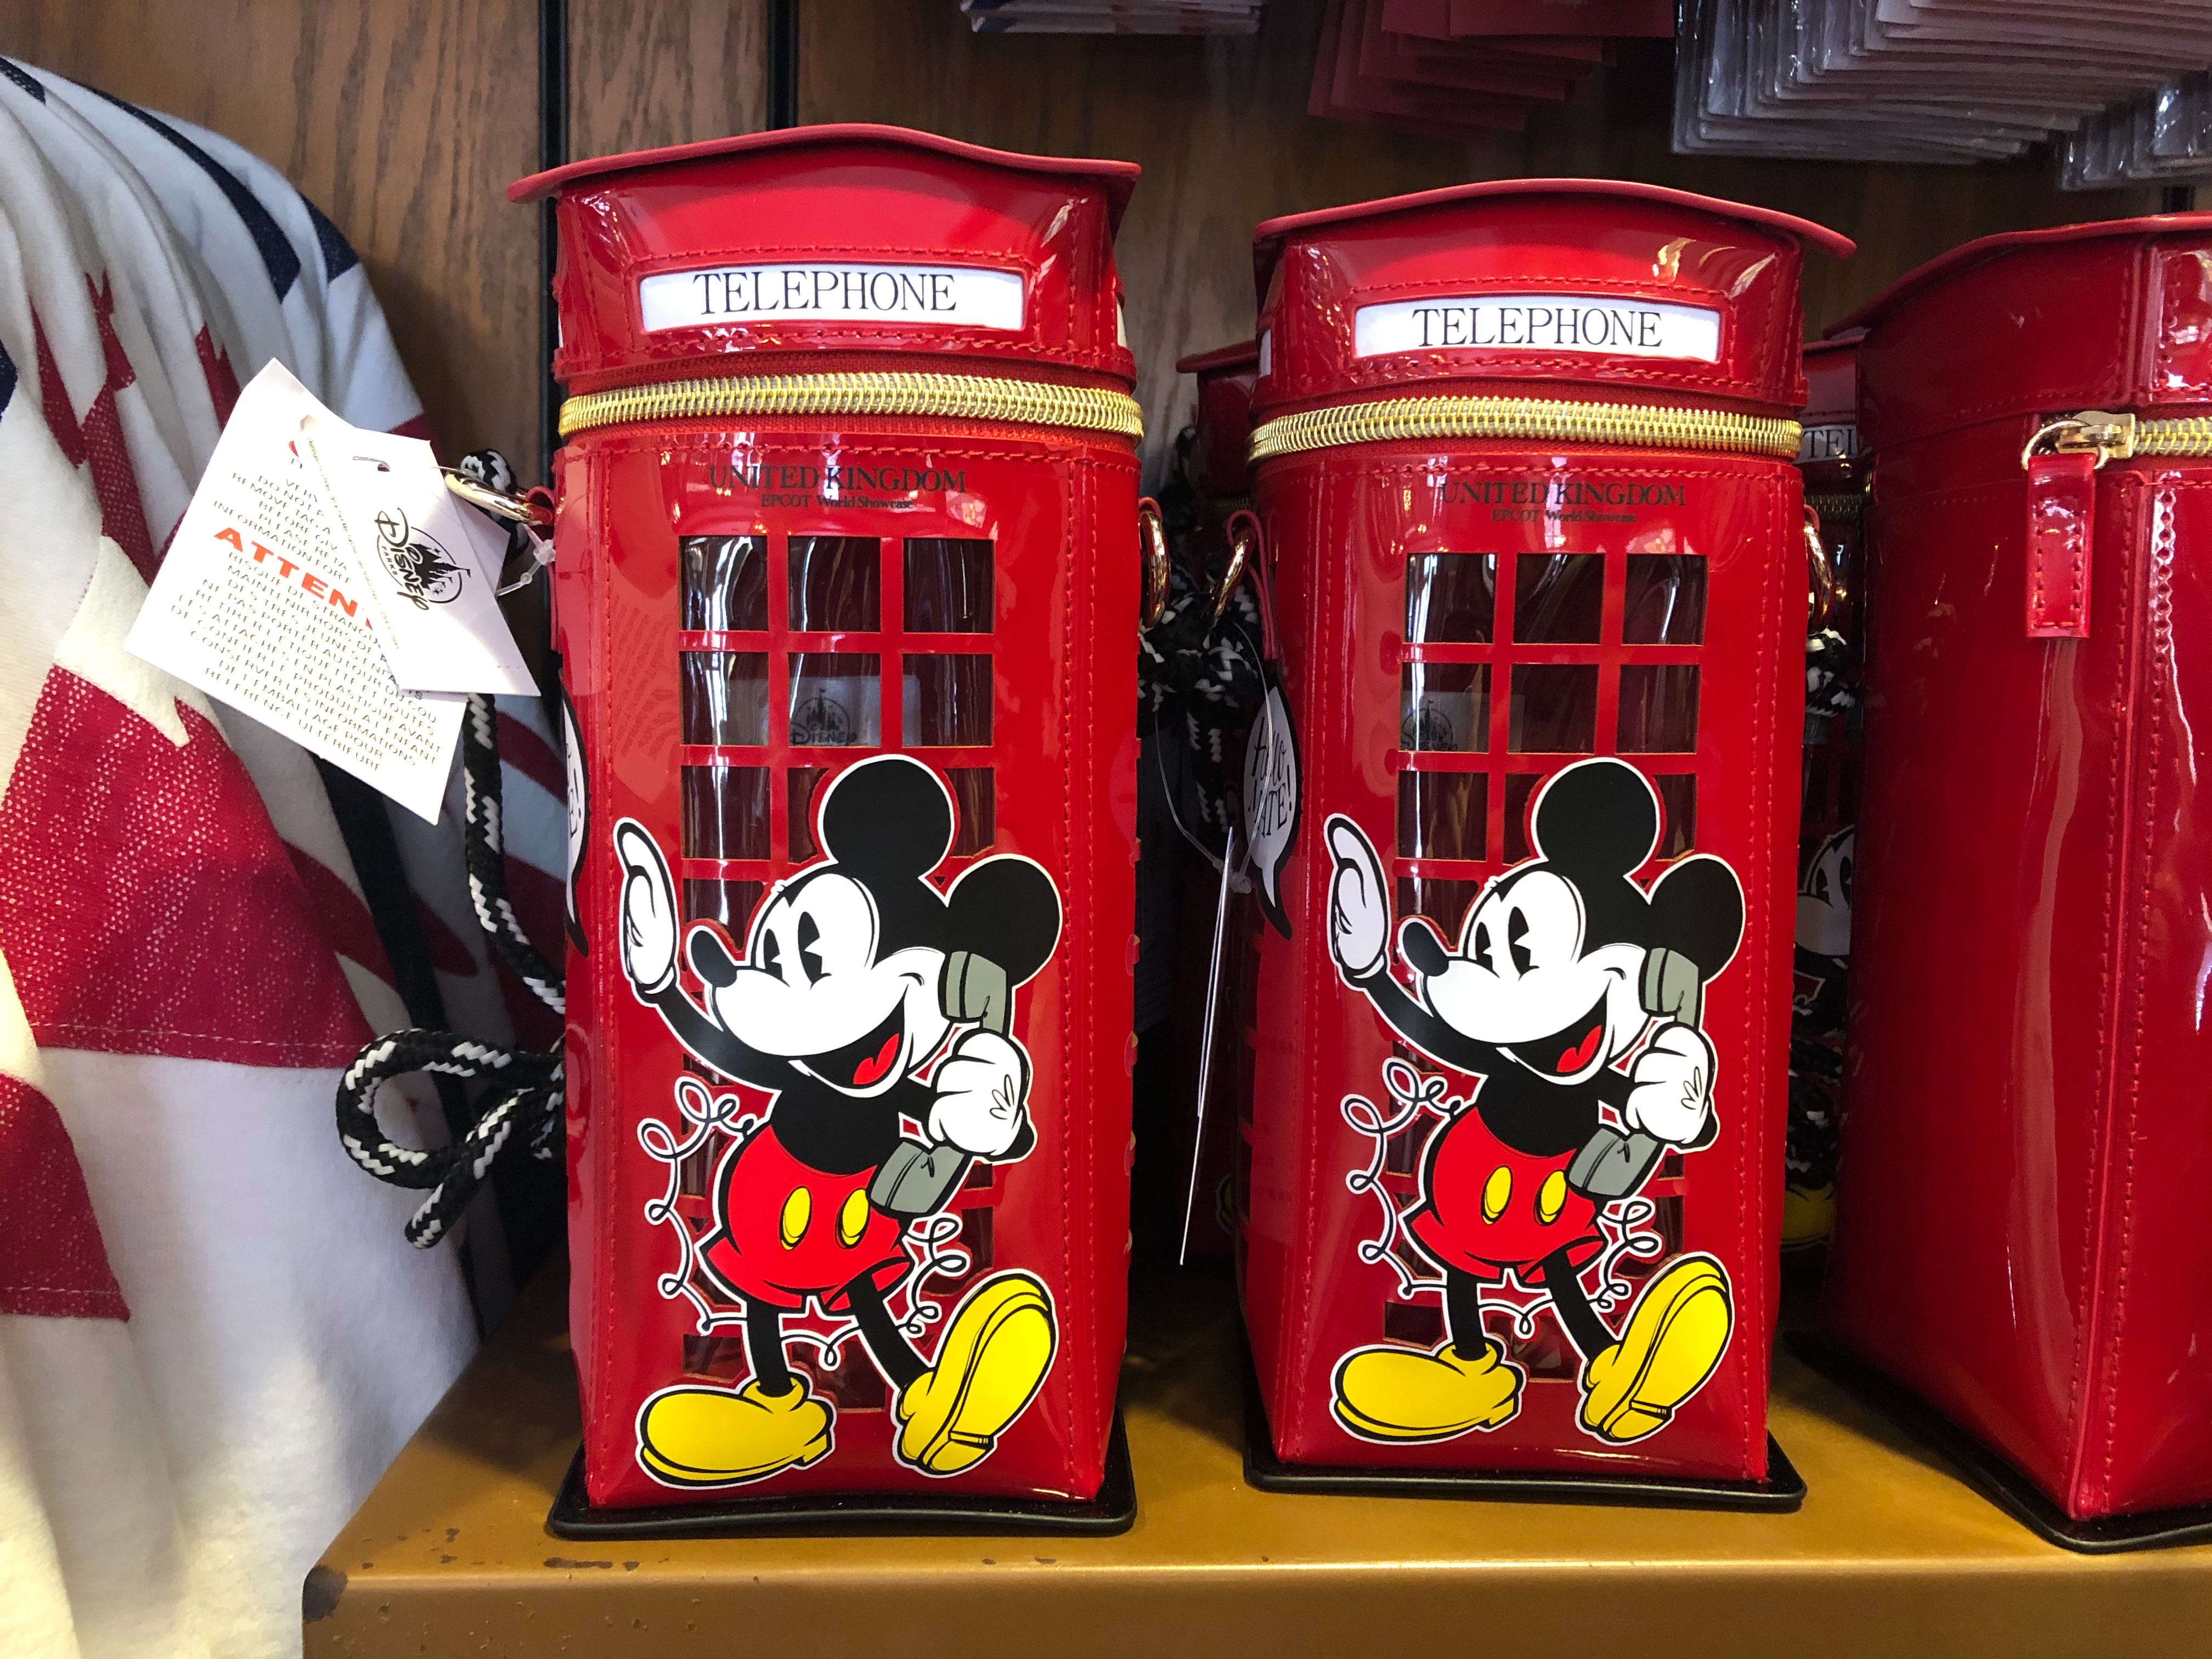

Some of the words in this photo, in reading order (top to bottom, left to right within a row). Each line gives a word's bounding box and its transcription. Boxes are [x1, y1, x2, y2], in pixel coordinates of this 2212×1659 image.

[693, 270, 957, 315] TELEPHONE
[1412, 308, 1663, 348] TELEPHONE
[710, 465, 820, 491] UNITED
[826, 466, 966, 493] KINGDOM
[1442, 482, 1549, 505] UNITED
[1556, 482, 1686, 507] KINGDOM
[761, 494, 809, 507] EPCOT
[816, 495, 855, 509] World
[857, 495, 915, 510] Showcase
[1492, 508, 1539, 522] EPCOT
[213, 527, 373, 630] ATTEN
[312, 600, 381, 648] STRANGU
